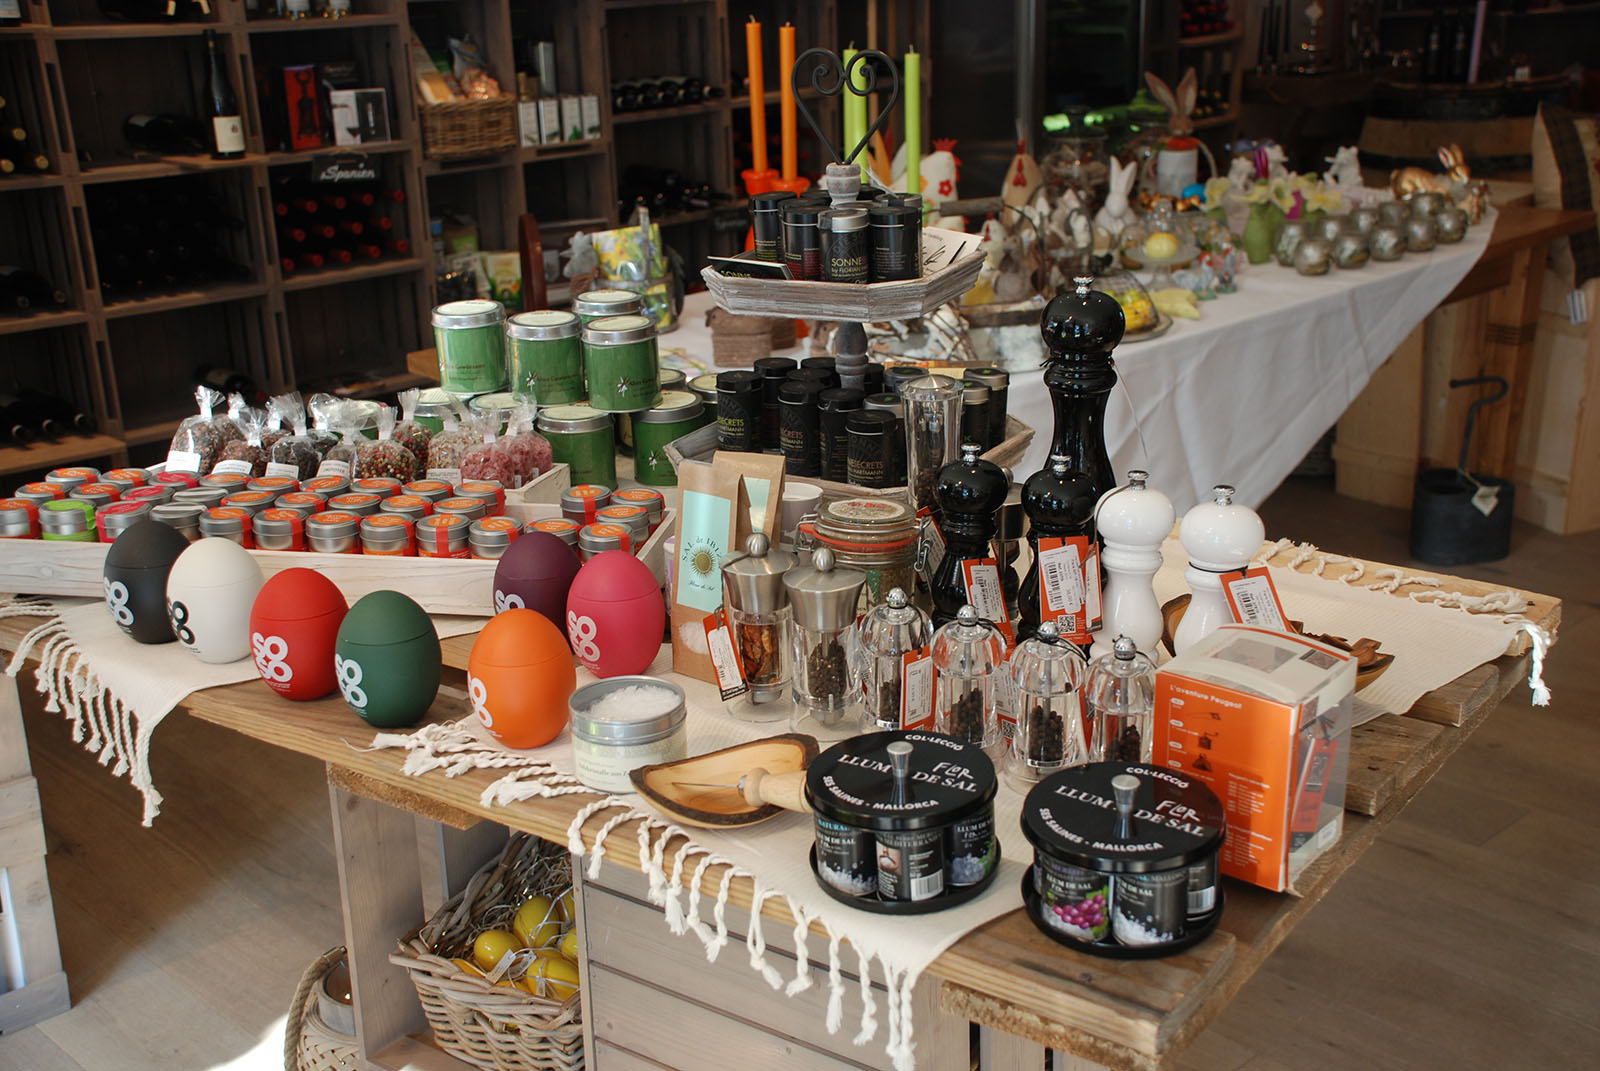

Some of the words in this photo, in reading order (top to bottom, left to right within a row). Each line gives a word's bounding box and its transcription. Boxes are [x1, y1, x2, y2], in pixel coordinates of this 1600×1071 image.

[321, 162, 375, 182] Spanien
[837, 754, 892, 774] LLUM
[912, 771, 941, 784] DE
[941, 777, 977, 792] SAL
[830, 782, 864, 806] SALINES
[872, 799, 939, 811] MALLORCA
[1055, 785, 1114, 809] LLUM
[1133, 809, 1165, 824] DE
[1165, 818, 1204, 837] SAL
[1046, 815, 1084, 844] SALINES
[1092, 841, 1164, 852] MALLORCA
